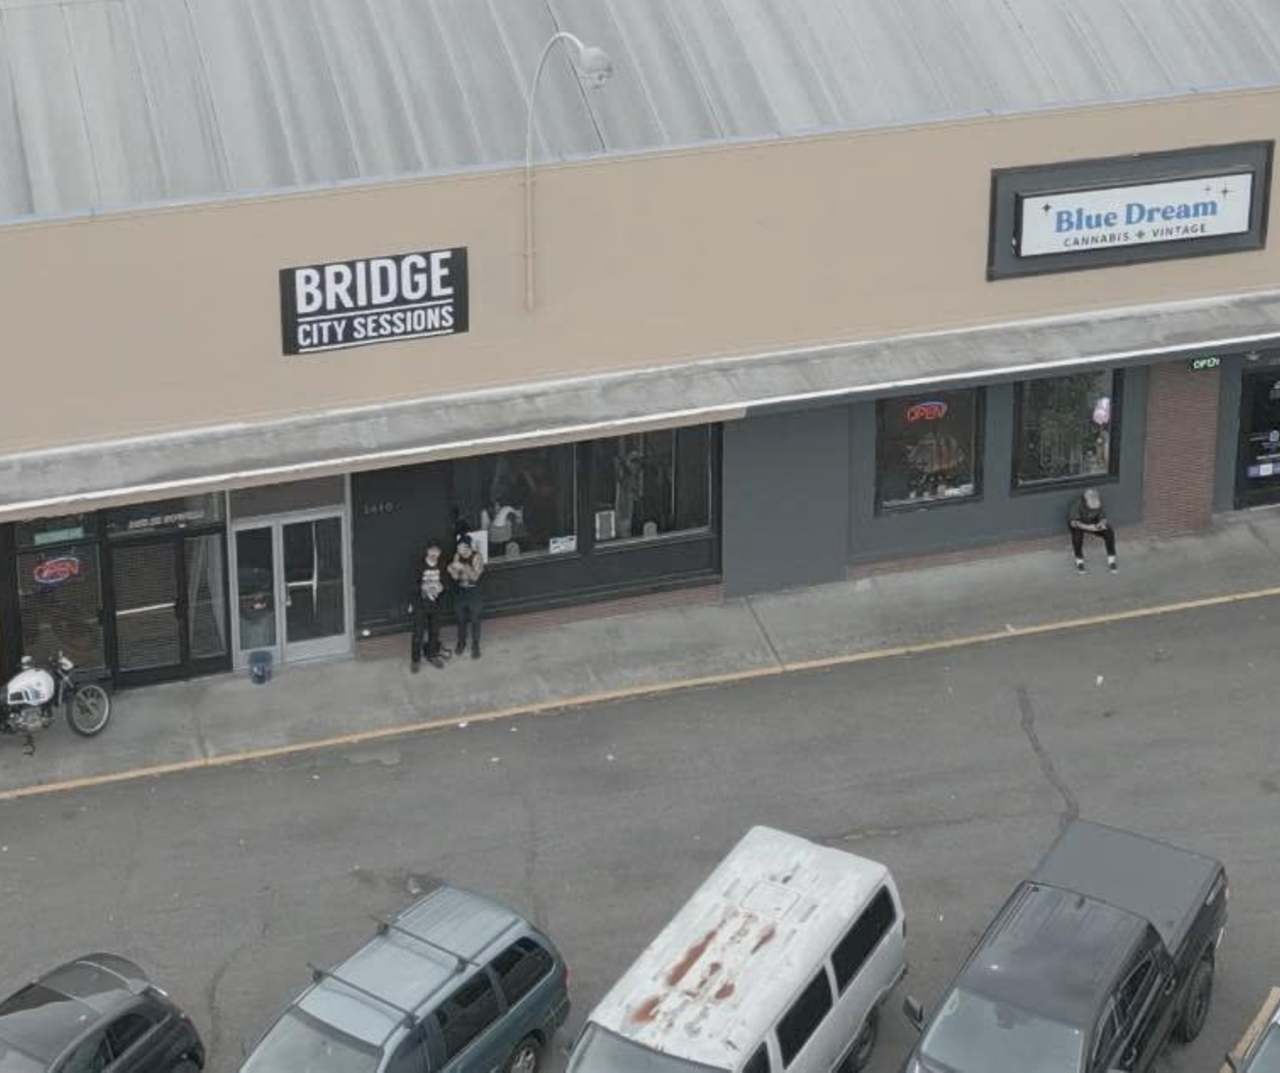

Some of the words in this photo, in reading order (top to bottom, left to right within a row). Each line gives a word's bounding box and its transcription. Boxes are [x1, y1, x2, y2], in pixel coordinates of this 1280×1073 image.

[1054, 209, 1118, 233] Blue
[1124, 199, 1218, 225] Dream
[1063, 231, 1130, 248] CANNABIS
[1152, 223, 1207, 238] VINTAGE
[295, 250, 454, 315] BRIDGE
[297, 319, 348, 347] CITY
[353, 305, 454, 339] SESSIONS
[907, 405, 946, 422] OPEN
